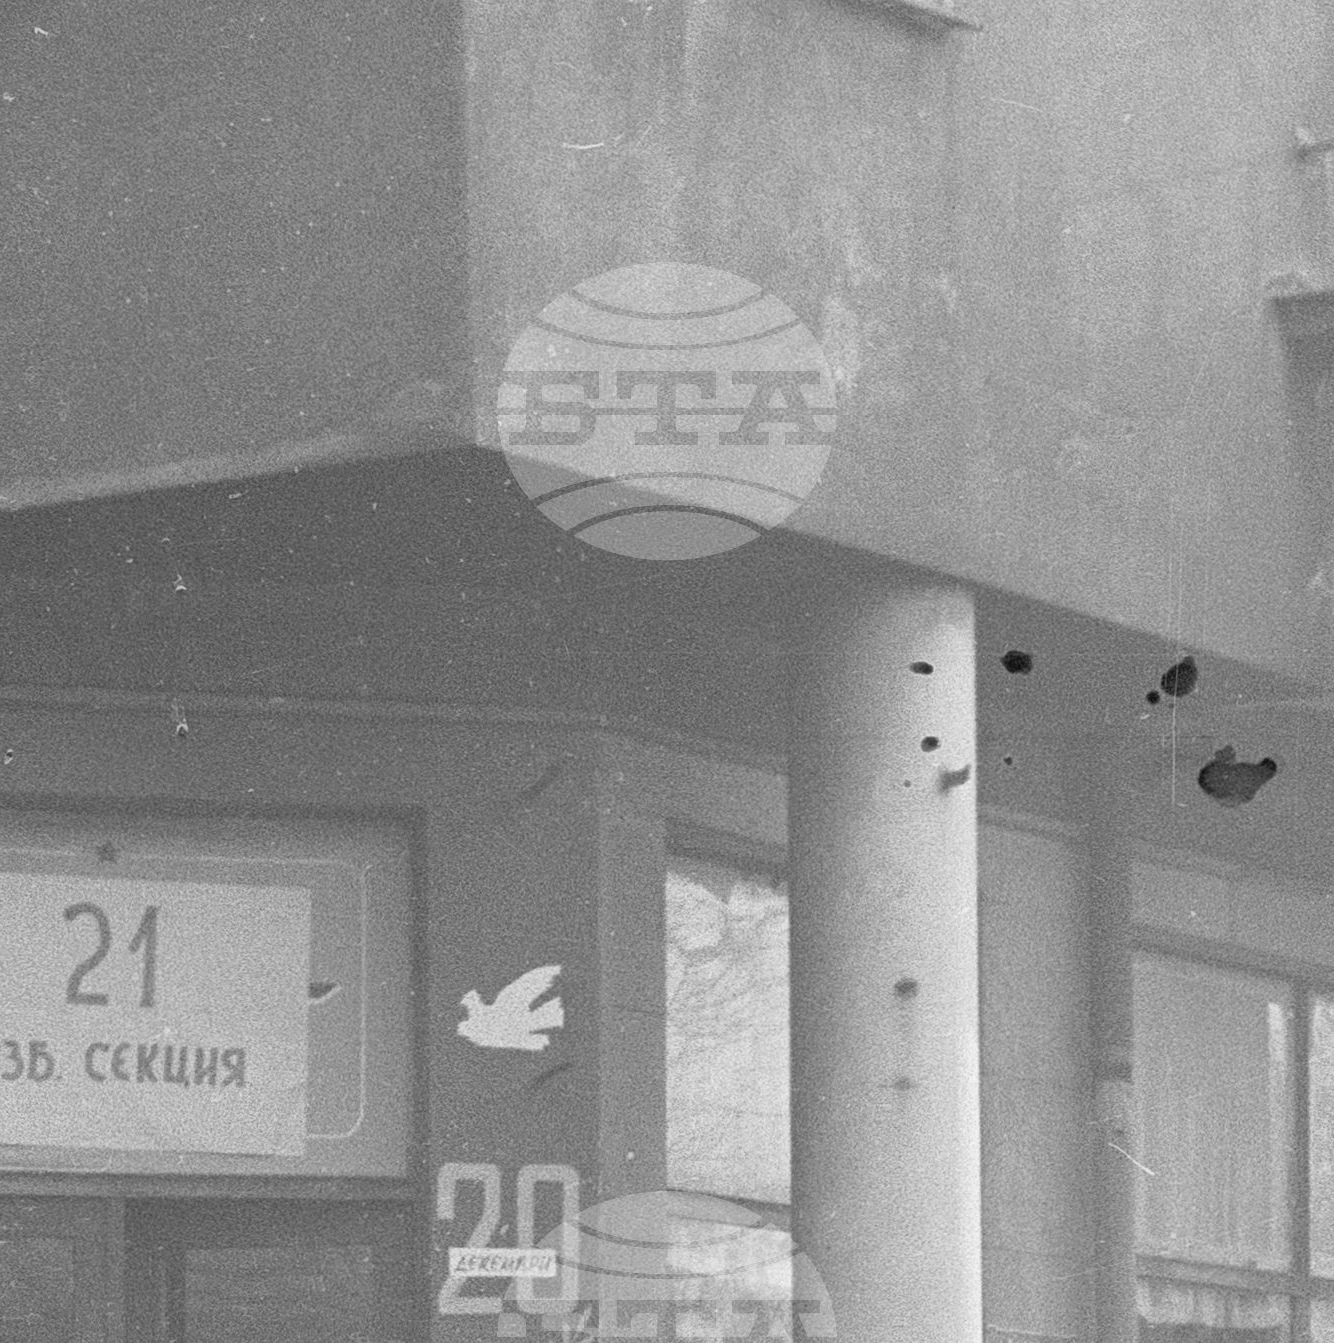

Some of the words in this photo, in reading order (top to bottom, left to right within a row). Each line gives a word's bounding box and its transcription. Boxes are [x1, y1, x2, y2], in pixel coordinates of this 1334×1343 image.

[63, 900, 159, 1008] 21
[84, 1041, 247, 1089] СЕКЦИЯ
[436, 1162, 580, 1315] 20
